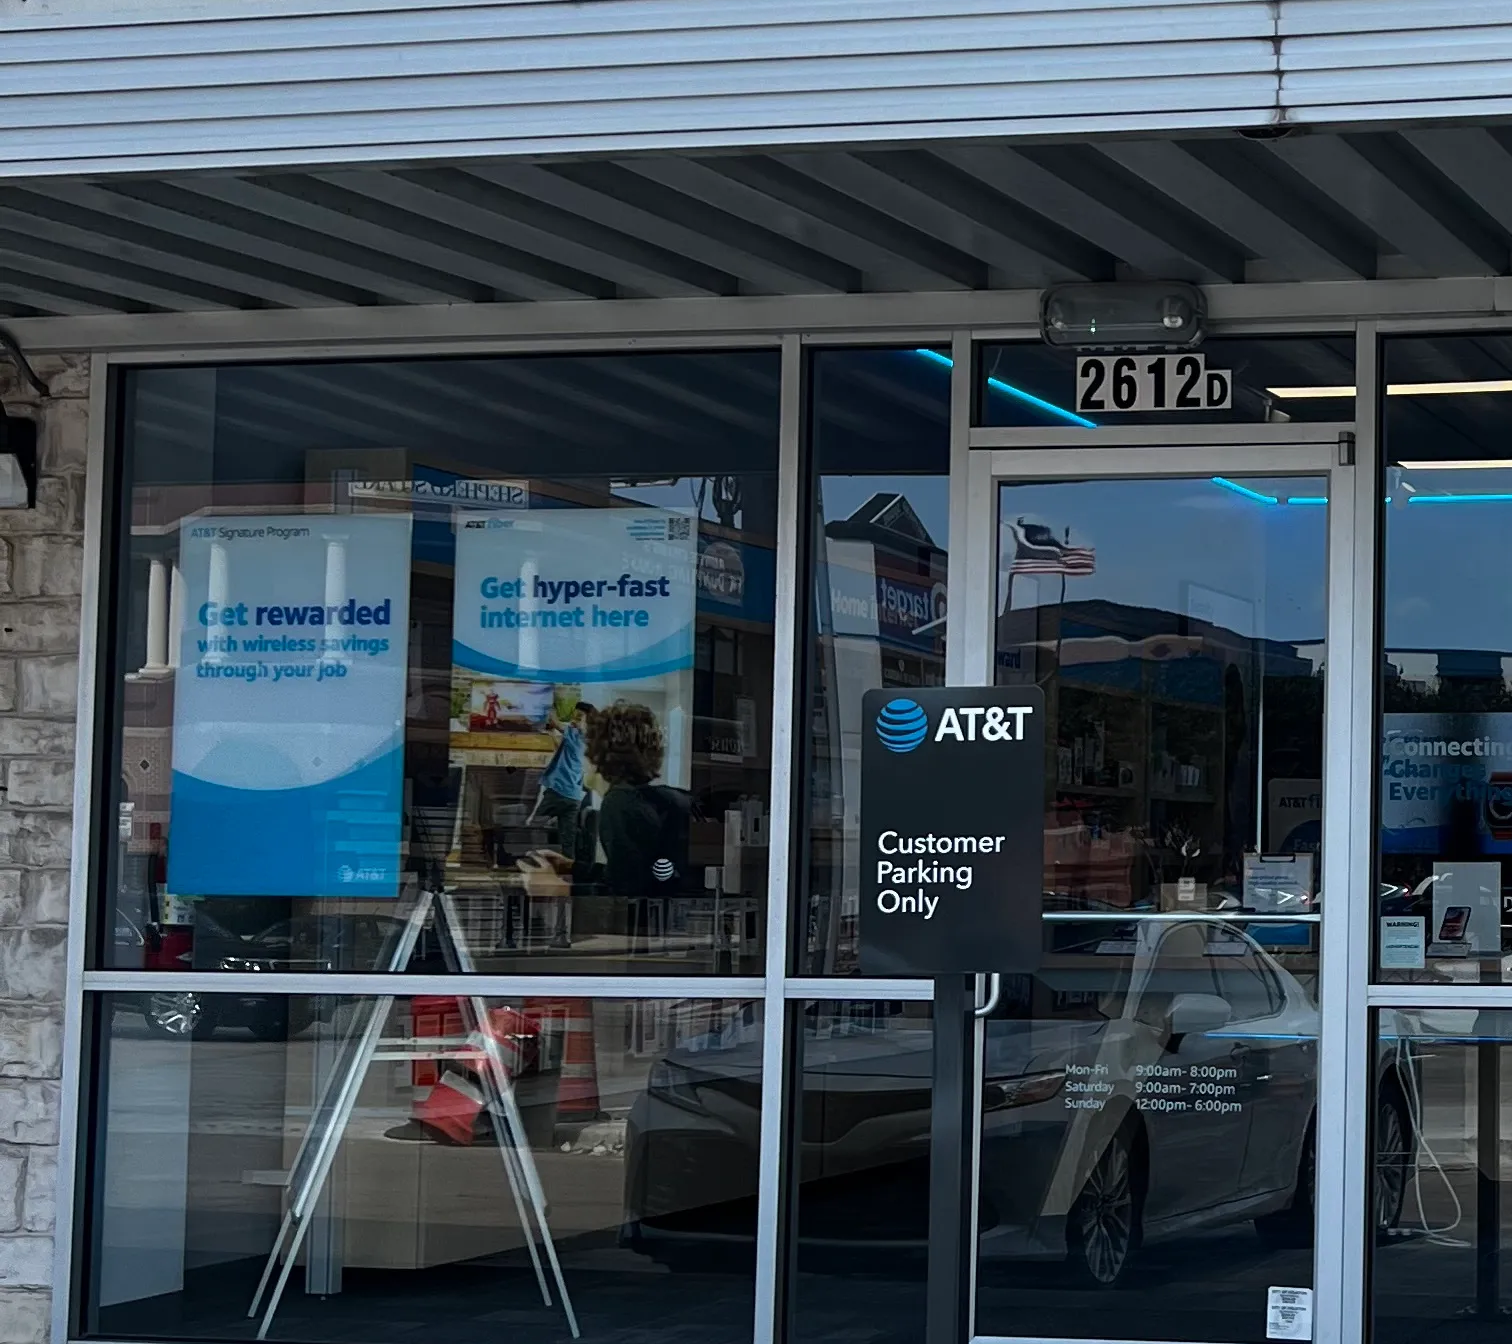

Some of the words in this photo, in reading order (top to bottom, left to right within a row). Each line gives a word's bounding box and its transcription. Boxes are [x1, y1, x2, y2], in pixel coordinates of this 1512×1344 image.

[191, 527, 216, 538] AT&T
[218, 526, 264, 540] Signature
[266, 526, 310, 540] Program
[480, 576, 526, 599] Get
[533, 573, 670, 604] hyper-fast
[198, 600, 248, 626] Get
[256, 598, 391, 626] rewarded
[480, 605, 585, 628] internet
[592, 604, 649, 627] here
[197, 635, 238, 653] with
[243, 634, 316, 652] wireless
[320, 634, 389, 656] savings
[196, 661, 268, 682] through
[273, 664, 314, 682] your
[316, 661, 347, 682] job
[934, 706, 1033, 742] AT&T
[1389, 759, 1486, 783] Changes
[1279, 796, 1307, 808] AT&T
[878, 830, 1005, 854] Customer
[877, 858, 973, 890] Parking
[877, 888, 939, 920] Only
[1065, 1064, 1109, 1075] Mon-Fri
[1190, 1065, 1237, 1080] 8:00pm
[1065, 1081, 1114, 1095] Saturday
[1189, 1082, 1236, 1097] 7:00pm
[1064, 1097, 1107, 1111] Sunday
[1195, 1099, 1242, 1114] 6:00pm
